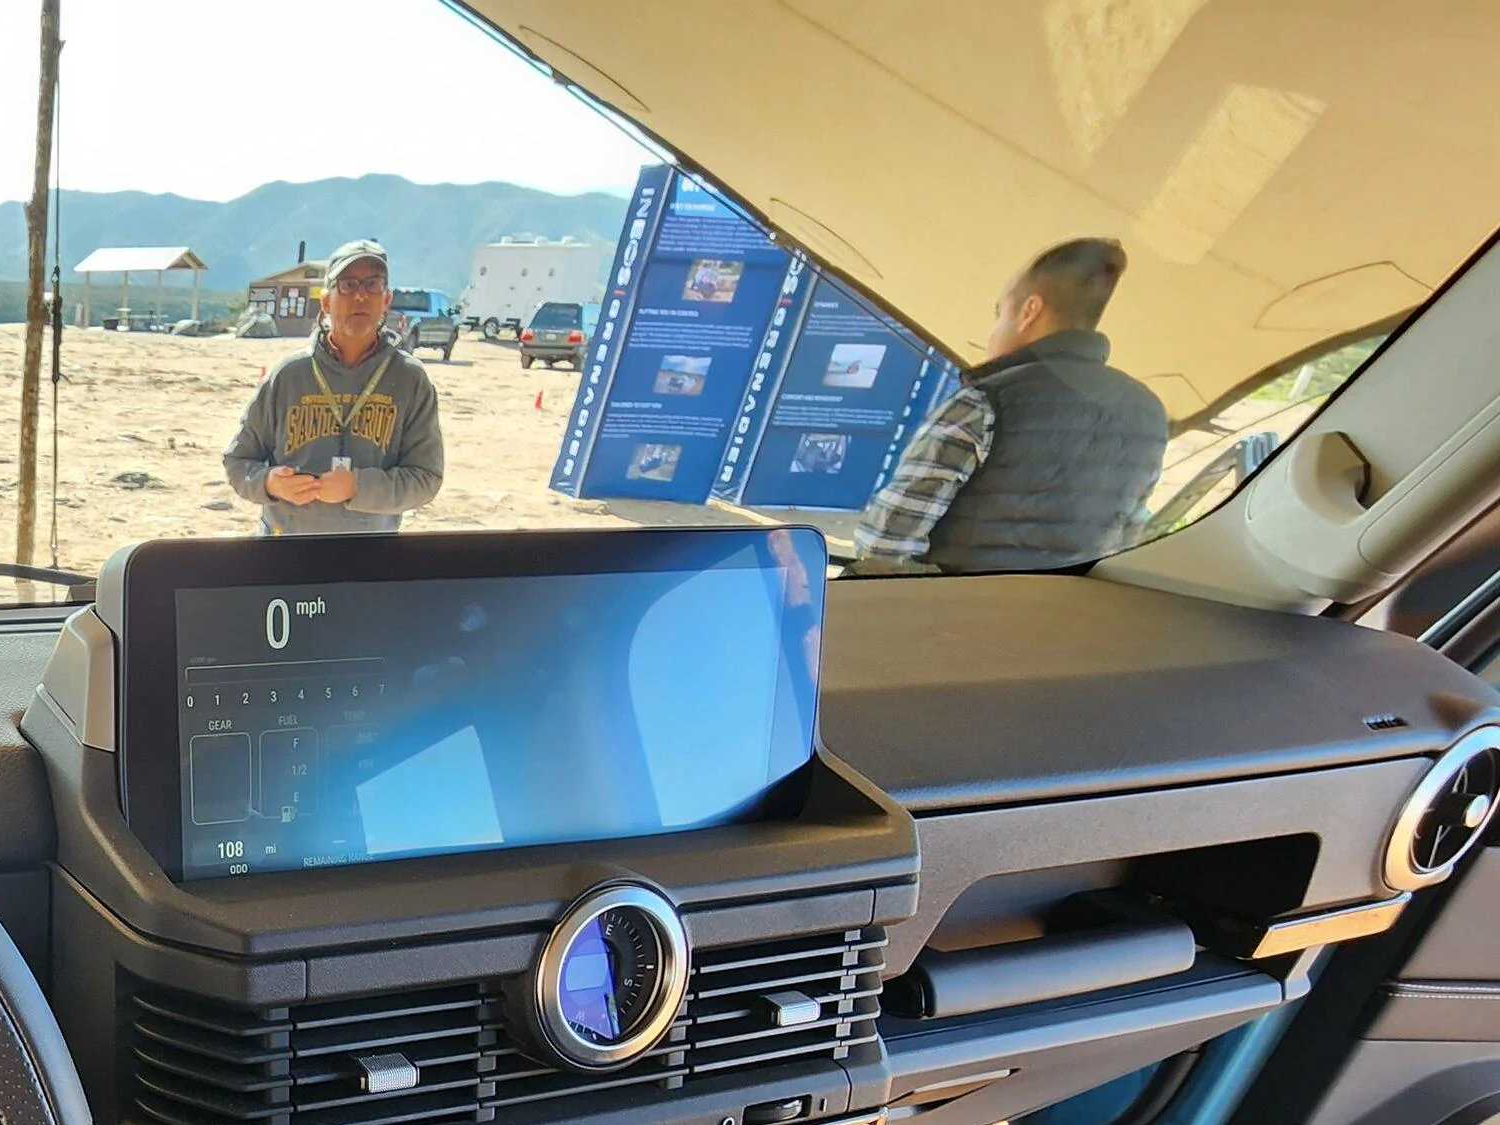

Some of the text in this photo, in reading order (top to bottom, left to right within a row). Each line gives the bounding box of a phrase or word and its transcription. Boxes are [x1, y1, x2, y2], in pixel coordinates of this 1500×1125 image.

[563, 187, 655, 476] INEOS GRENADIER
[720, 307, 787, 482] GRENADIER
[266, 597, 326, 650] 0 mph
[187, 684, 385, 708] 0 1 2 3 4 5 6 7
[208, 720, 232, 731] GEAR
[279, 715, 298, 726] FUEL
[294, 738, 299, 748] F
[292, 765, 307, 776] 1/2
[294, 792, 299, 802] E
[218, 841, 276, 859] 108 mi
[303, 854, 347, 867] REMAINING
[230, 863, 248, 874] ODO
[605, 924, 613, 936] E
